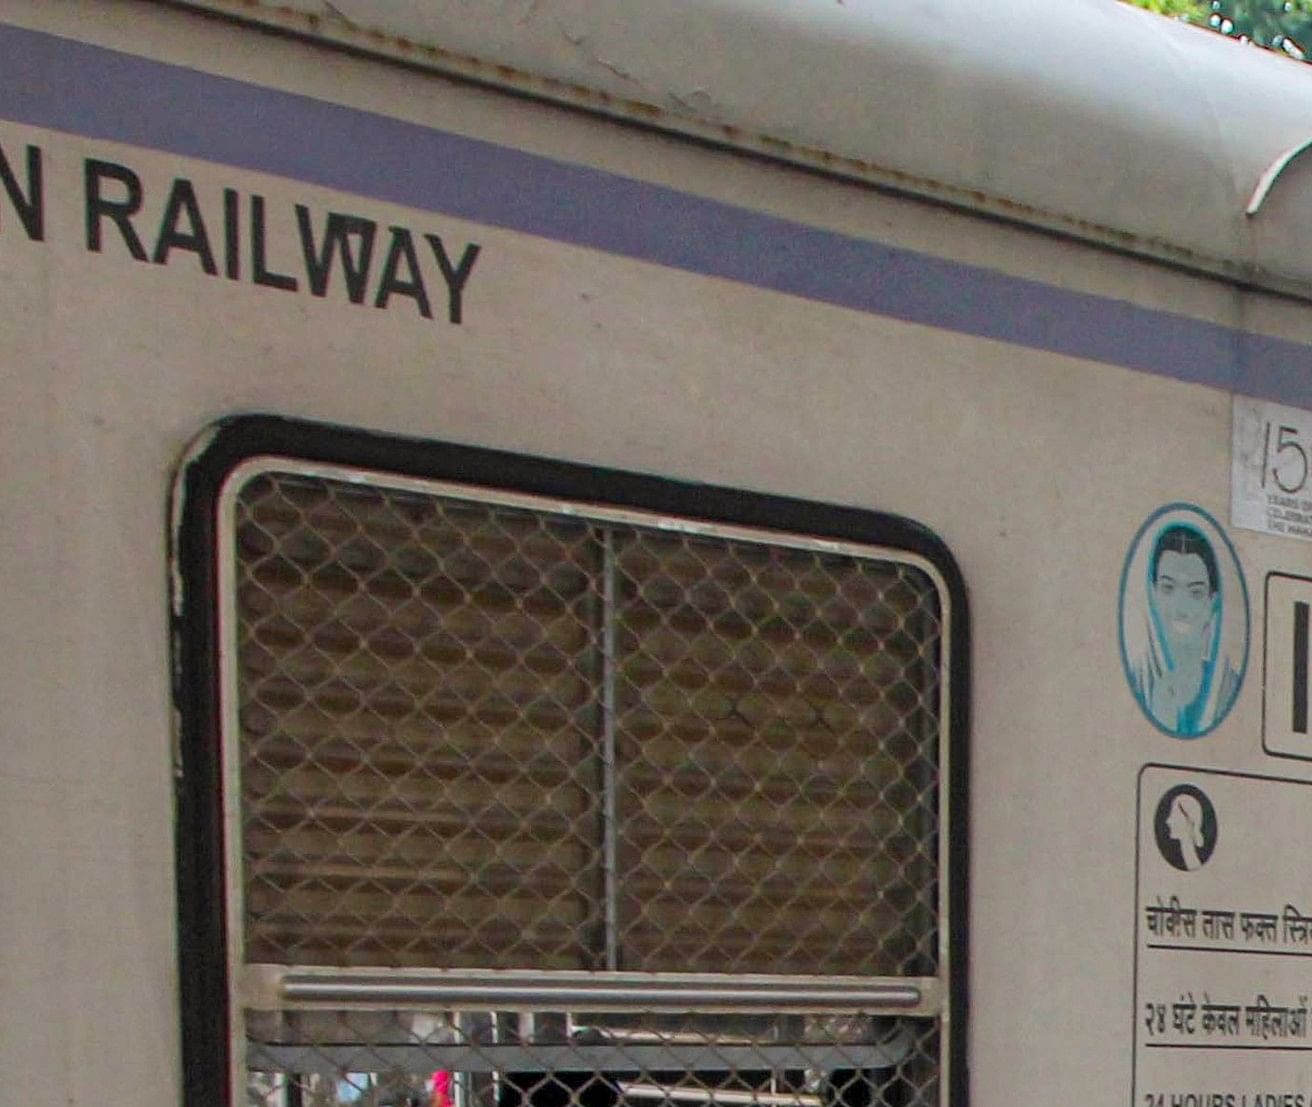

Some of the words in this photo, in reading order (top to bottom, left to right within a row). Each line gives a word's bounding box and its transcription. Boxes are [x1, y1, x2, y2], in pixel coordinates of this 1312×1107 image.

[84, 157, 482, 324] RAILWAY
[1202, 910, 1235, 940] तास
[1239, 912, 1279, 943] फक्त
[1145, 1003, 1166, 1036] २४
[1173, 991, 1197, 1035] घंटे
[1201, 991, 1241, 1036] केवल
[1245, 994, 1307, 1041] महिलाओं
